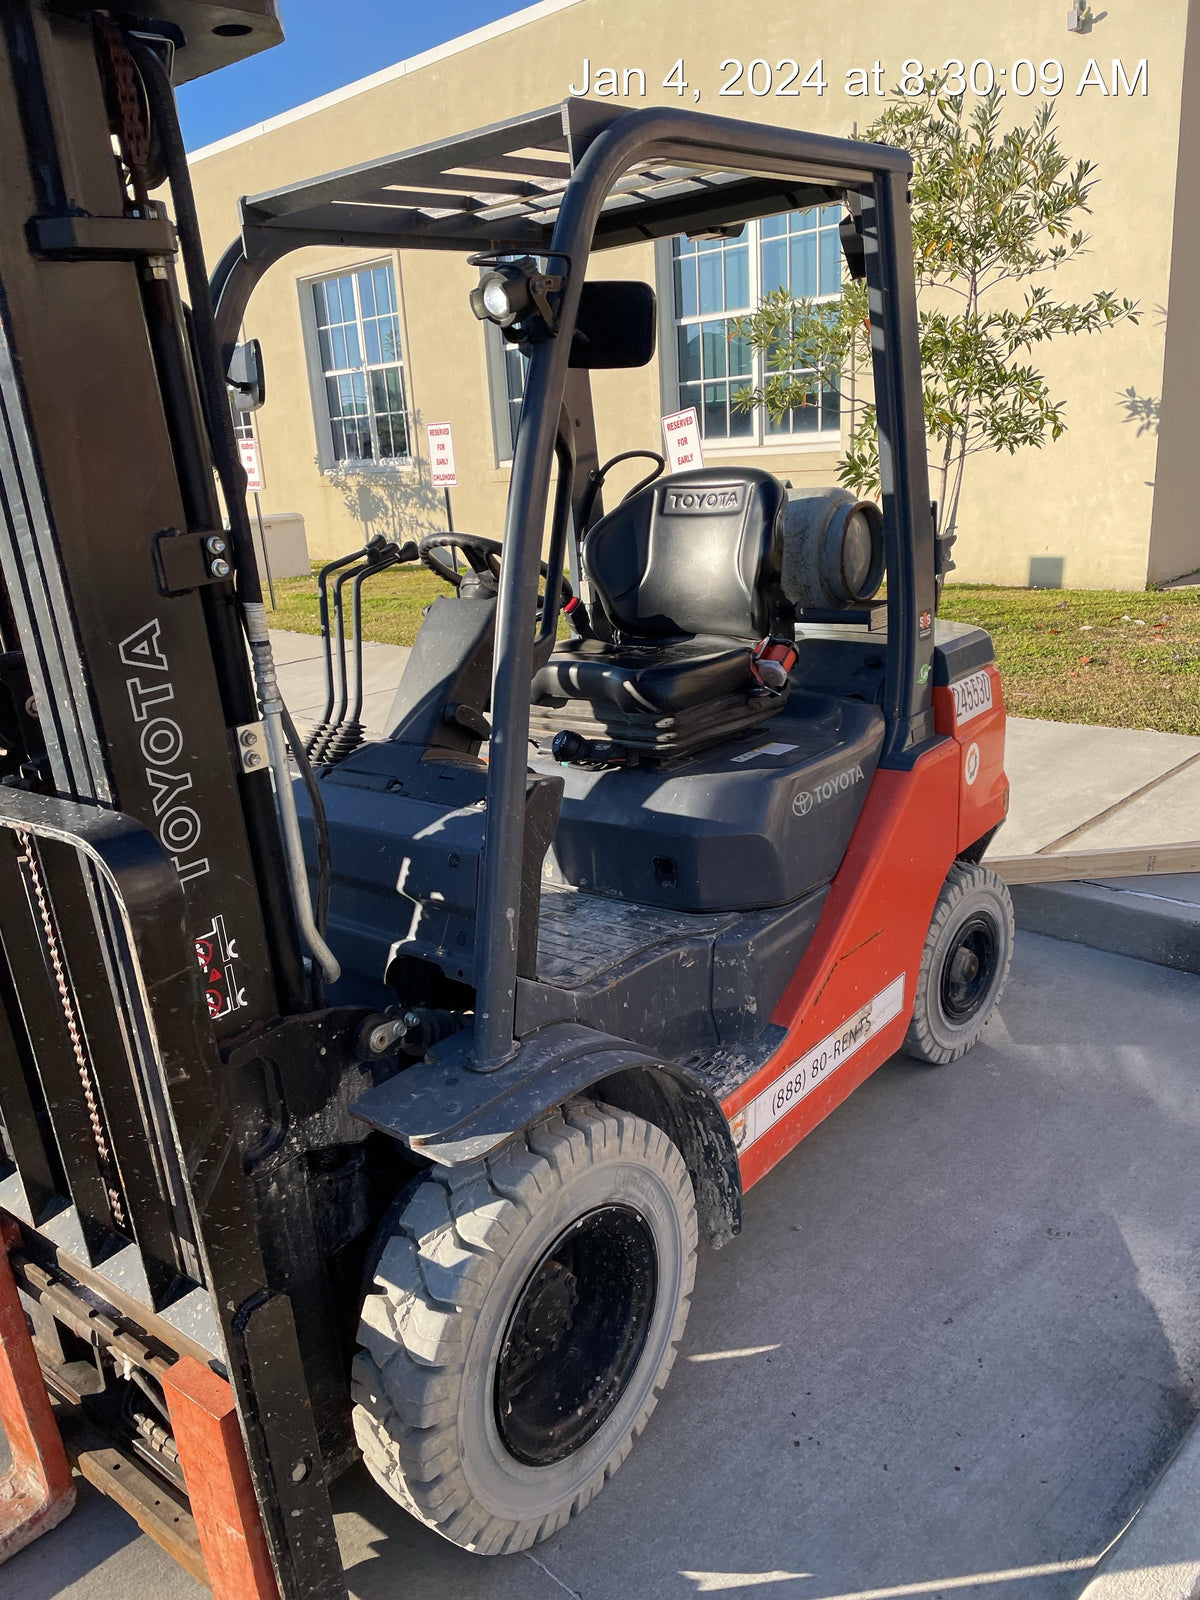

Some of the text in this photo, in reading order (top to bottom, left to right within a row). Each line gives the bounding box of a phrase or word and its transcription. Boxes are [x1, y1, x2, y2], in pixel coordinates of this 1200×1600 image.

[667, 416, 693, 431] RESERVED
[677, 436, 688, 447] FOR
[677, 453, 694, 465] EARLY
[670, 491, 738, 510] TOYOTA
[919, 612, 931, 629] SAS
[951, 673, 991, 718] 245530
[118, 617, 210, 895] TOYOTA
[813, 764, 865, 804] TOYOTA
[771, 1069, 806, 1116] (888)
